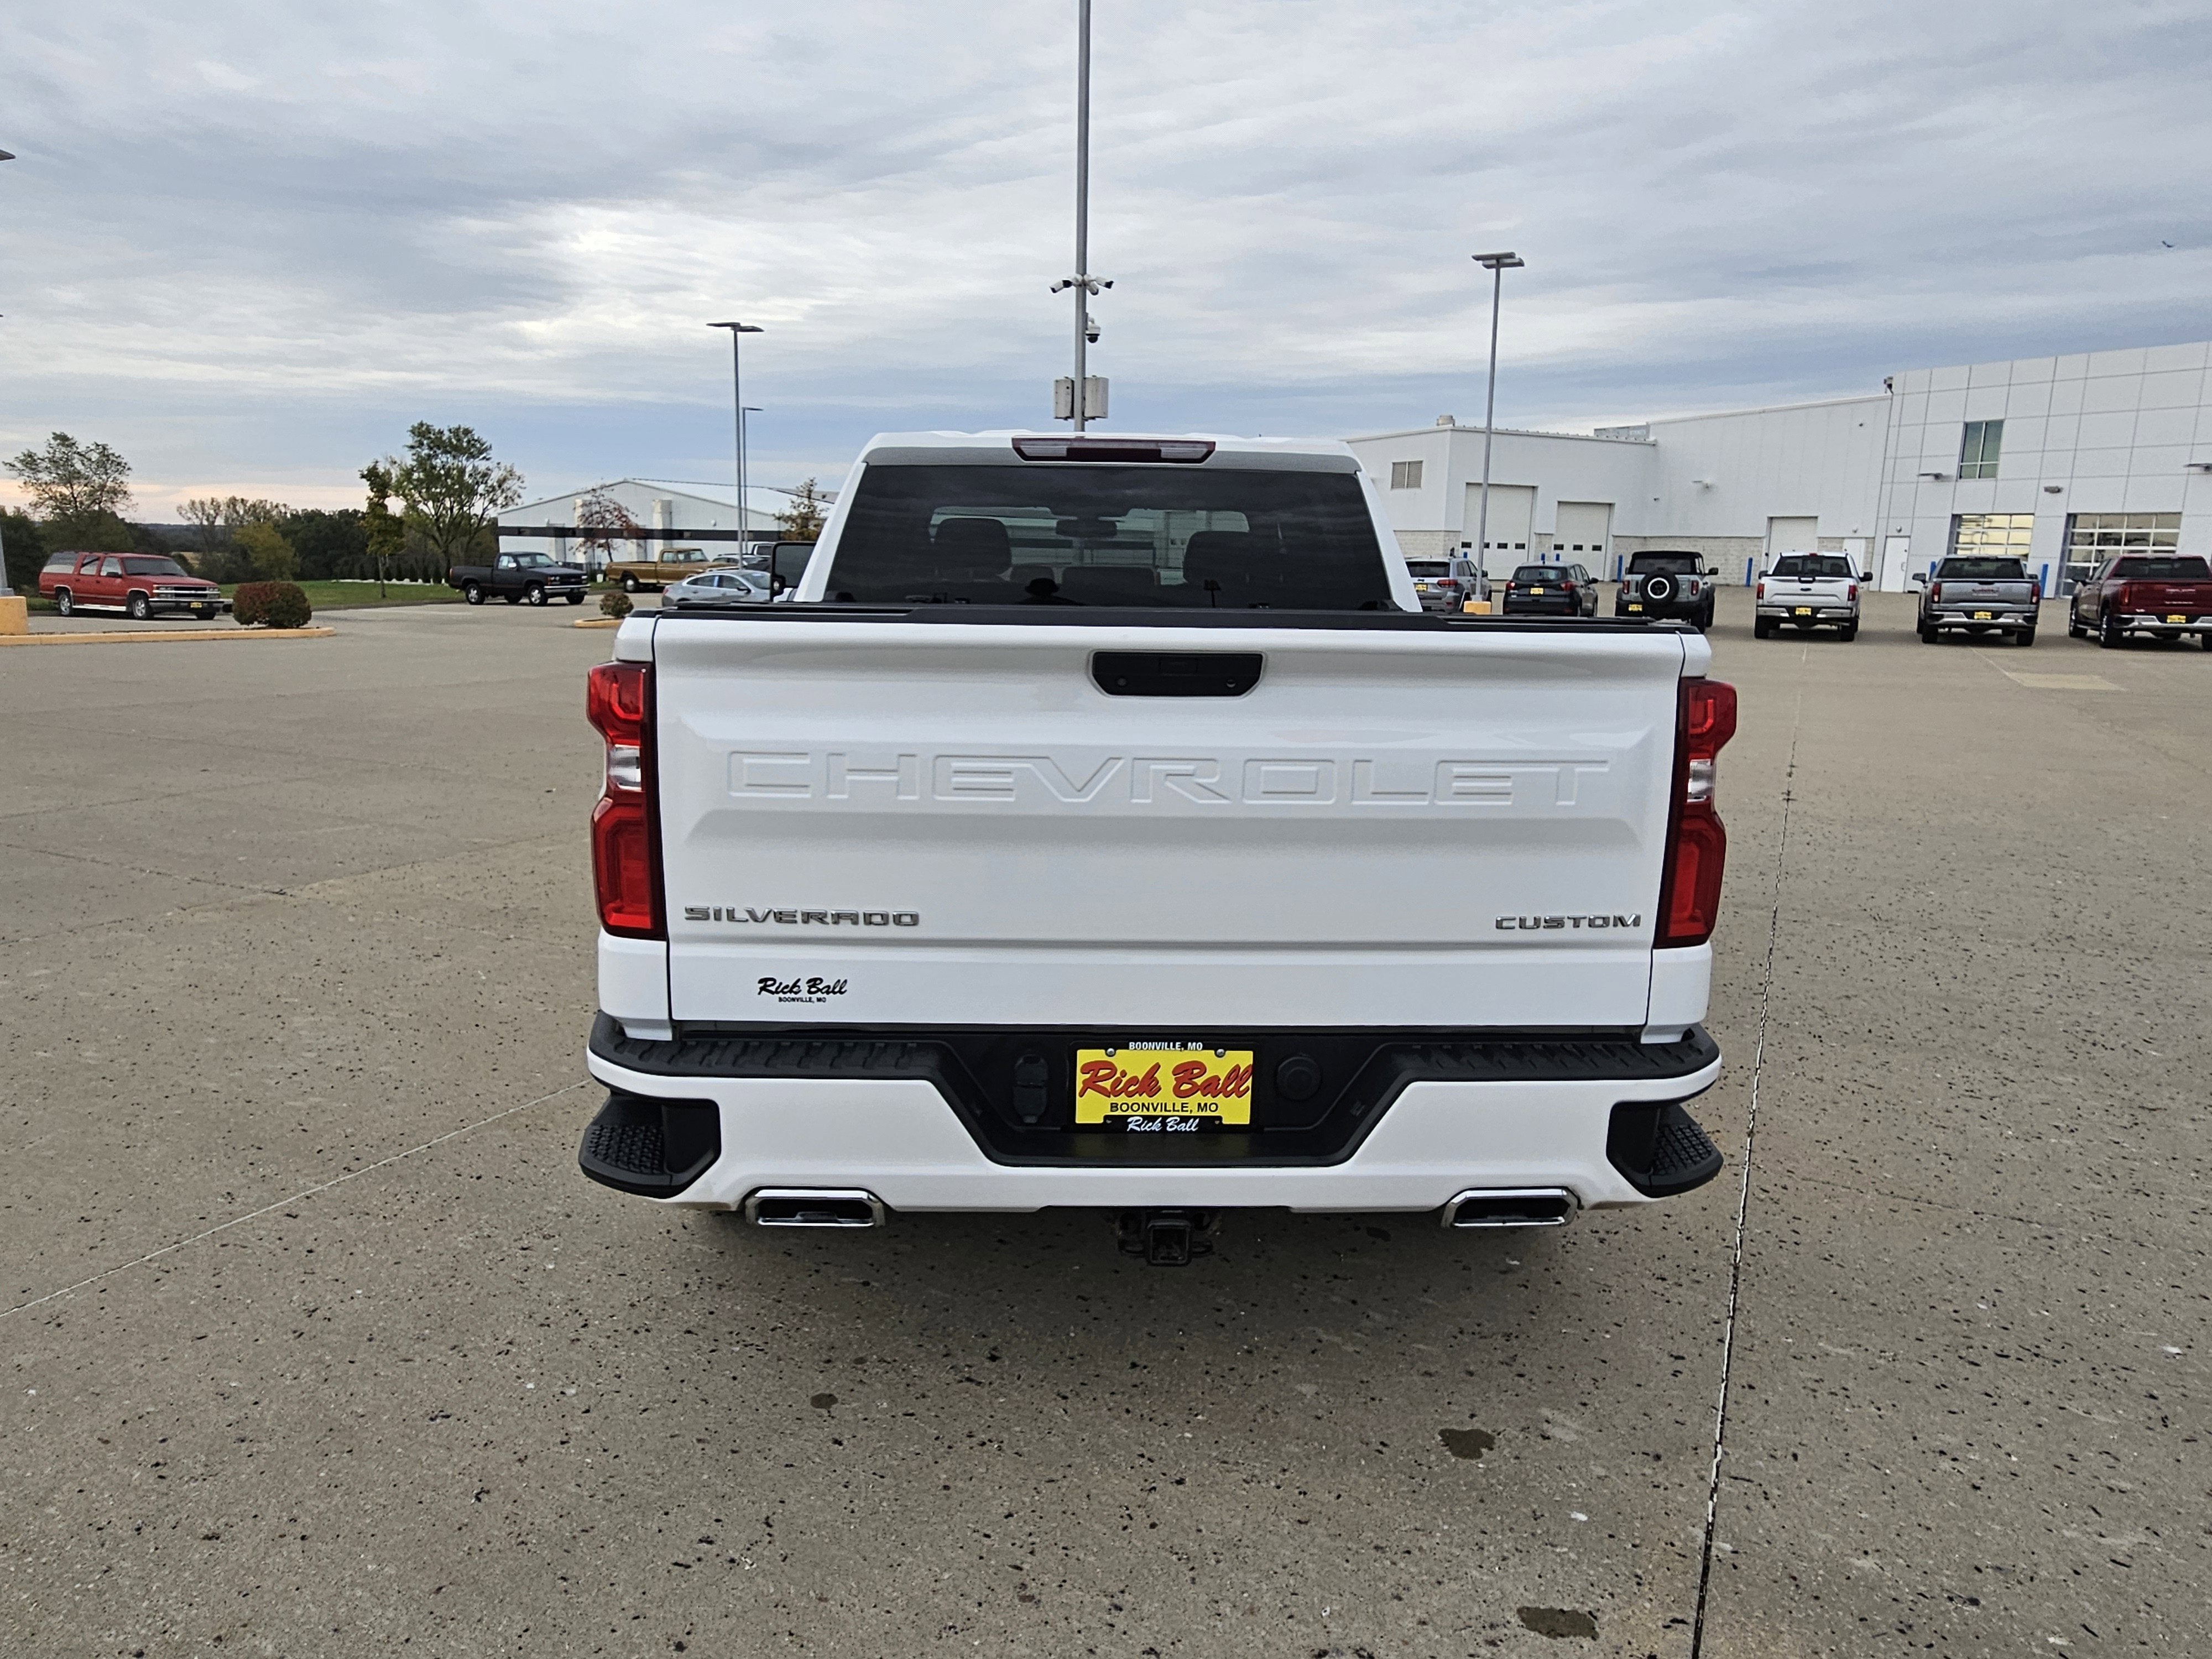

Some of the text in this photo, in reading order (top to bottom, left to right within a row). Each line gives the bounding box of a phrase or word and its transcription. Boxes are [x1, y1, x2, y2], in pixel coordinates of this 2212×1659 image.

[728, 750, 1610, 806] CHEVROLET
[685, 905, 920, 926] SILVERADO
[1495, 914, 1641, 930] CUSTOM
[758, 977, 848, 995] Rick Ball
[1129, 1042, 1203, 1052] BOONVILLE, MO
[1078, 1060, 1253, 1098] Rick Ball
[1110, 1102, 1219, 1114] BOONVILLE, MO
[1127, 1116, 1199, 1132] Rick Ball
